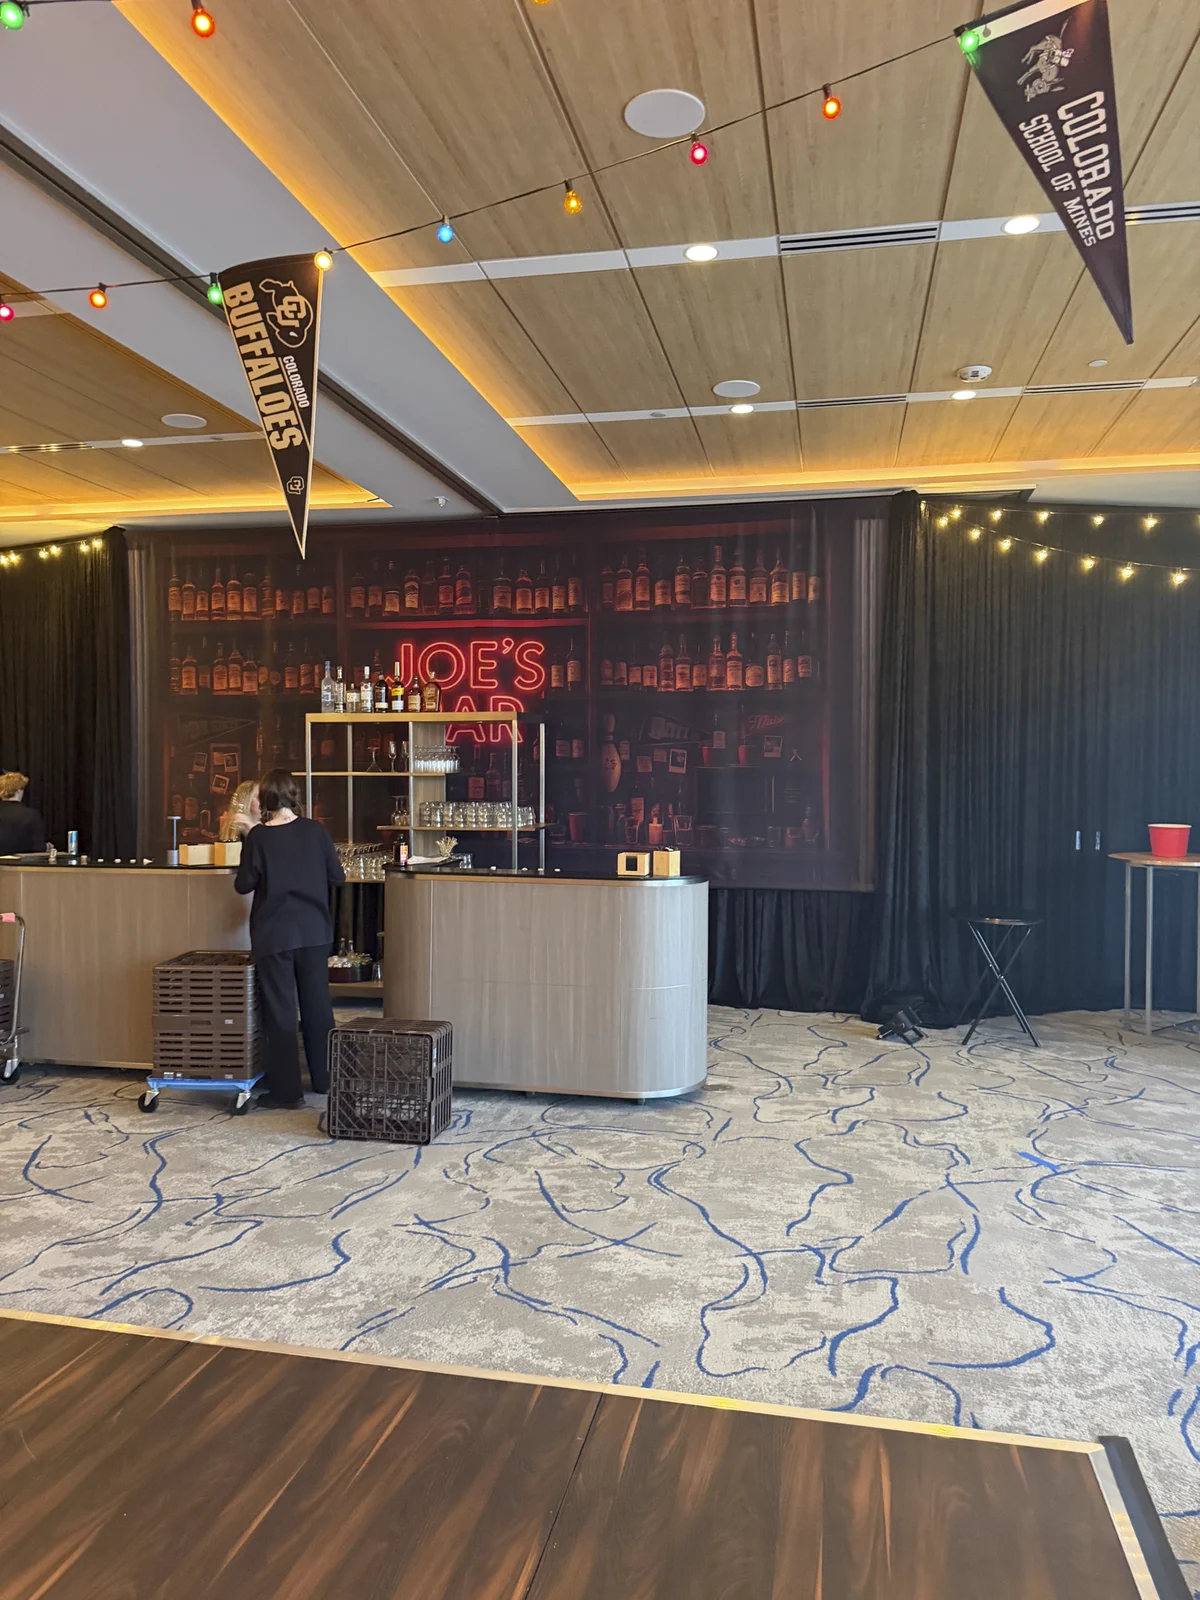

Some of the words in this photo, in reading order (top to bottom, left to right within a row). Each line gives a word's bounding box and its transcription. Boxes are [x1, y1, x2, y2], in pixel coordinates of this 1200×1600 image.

[1018, 114, 1065, 173] SCHOOL
[1057, 91, 1115, 241] COLORADO
[1050, 172, 1077, 192] OF
[1063, 197, 1097, 247] MINES
[223, 280, 304, 451] BUFFALOES
[283, 355, 310, 409] COLORADO
[386, 637, 546, 691] JOE'S
[438, 695, 523, 743] AR
